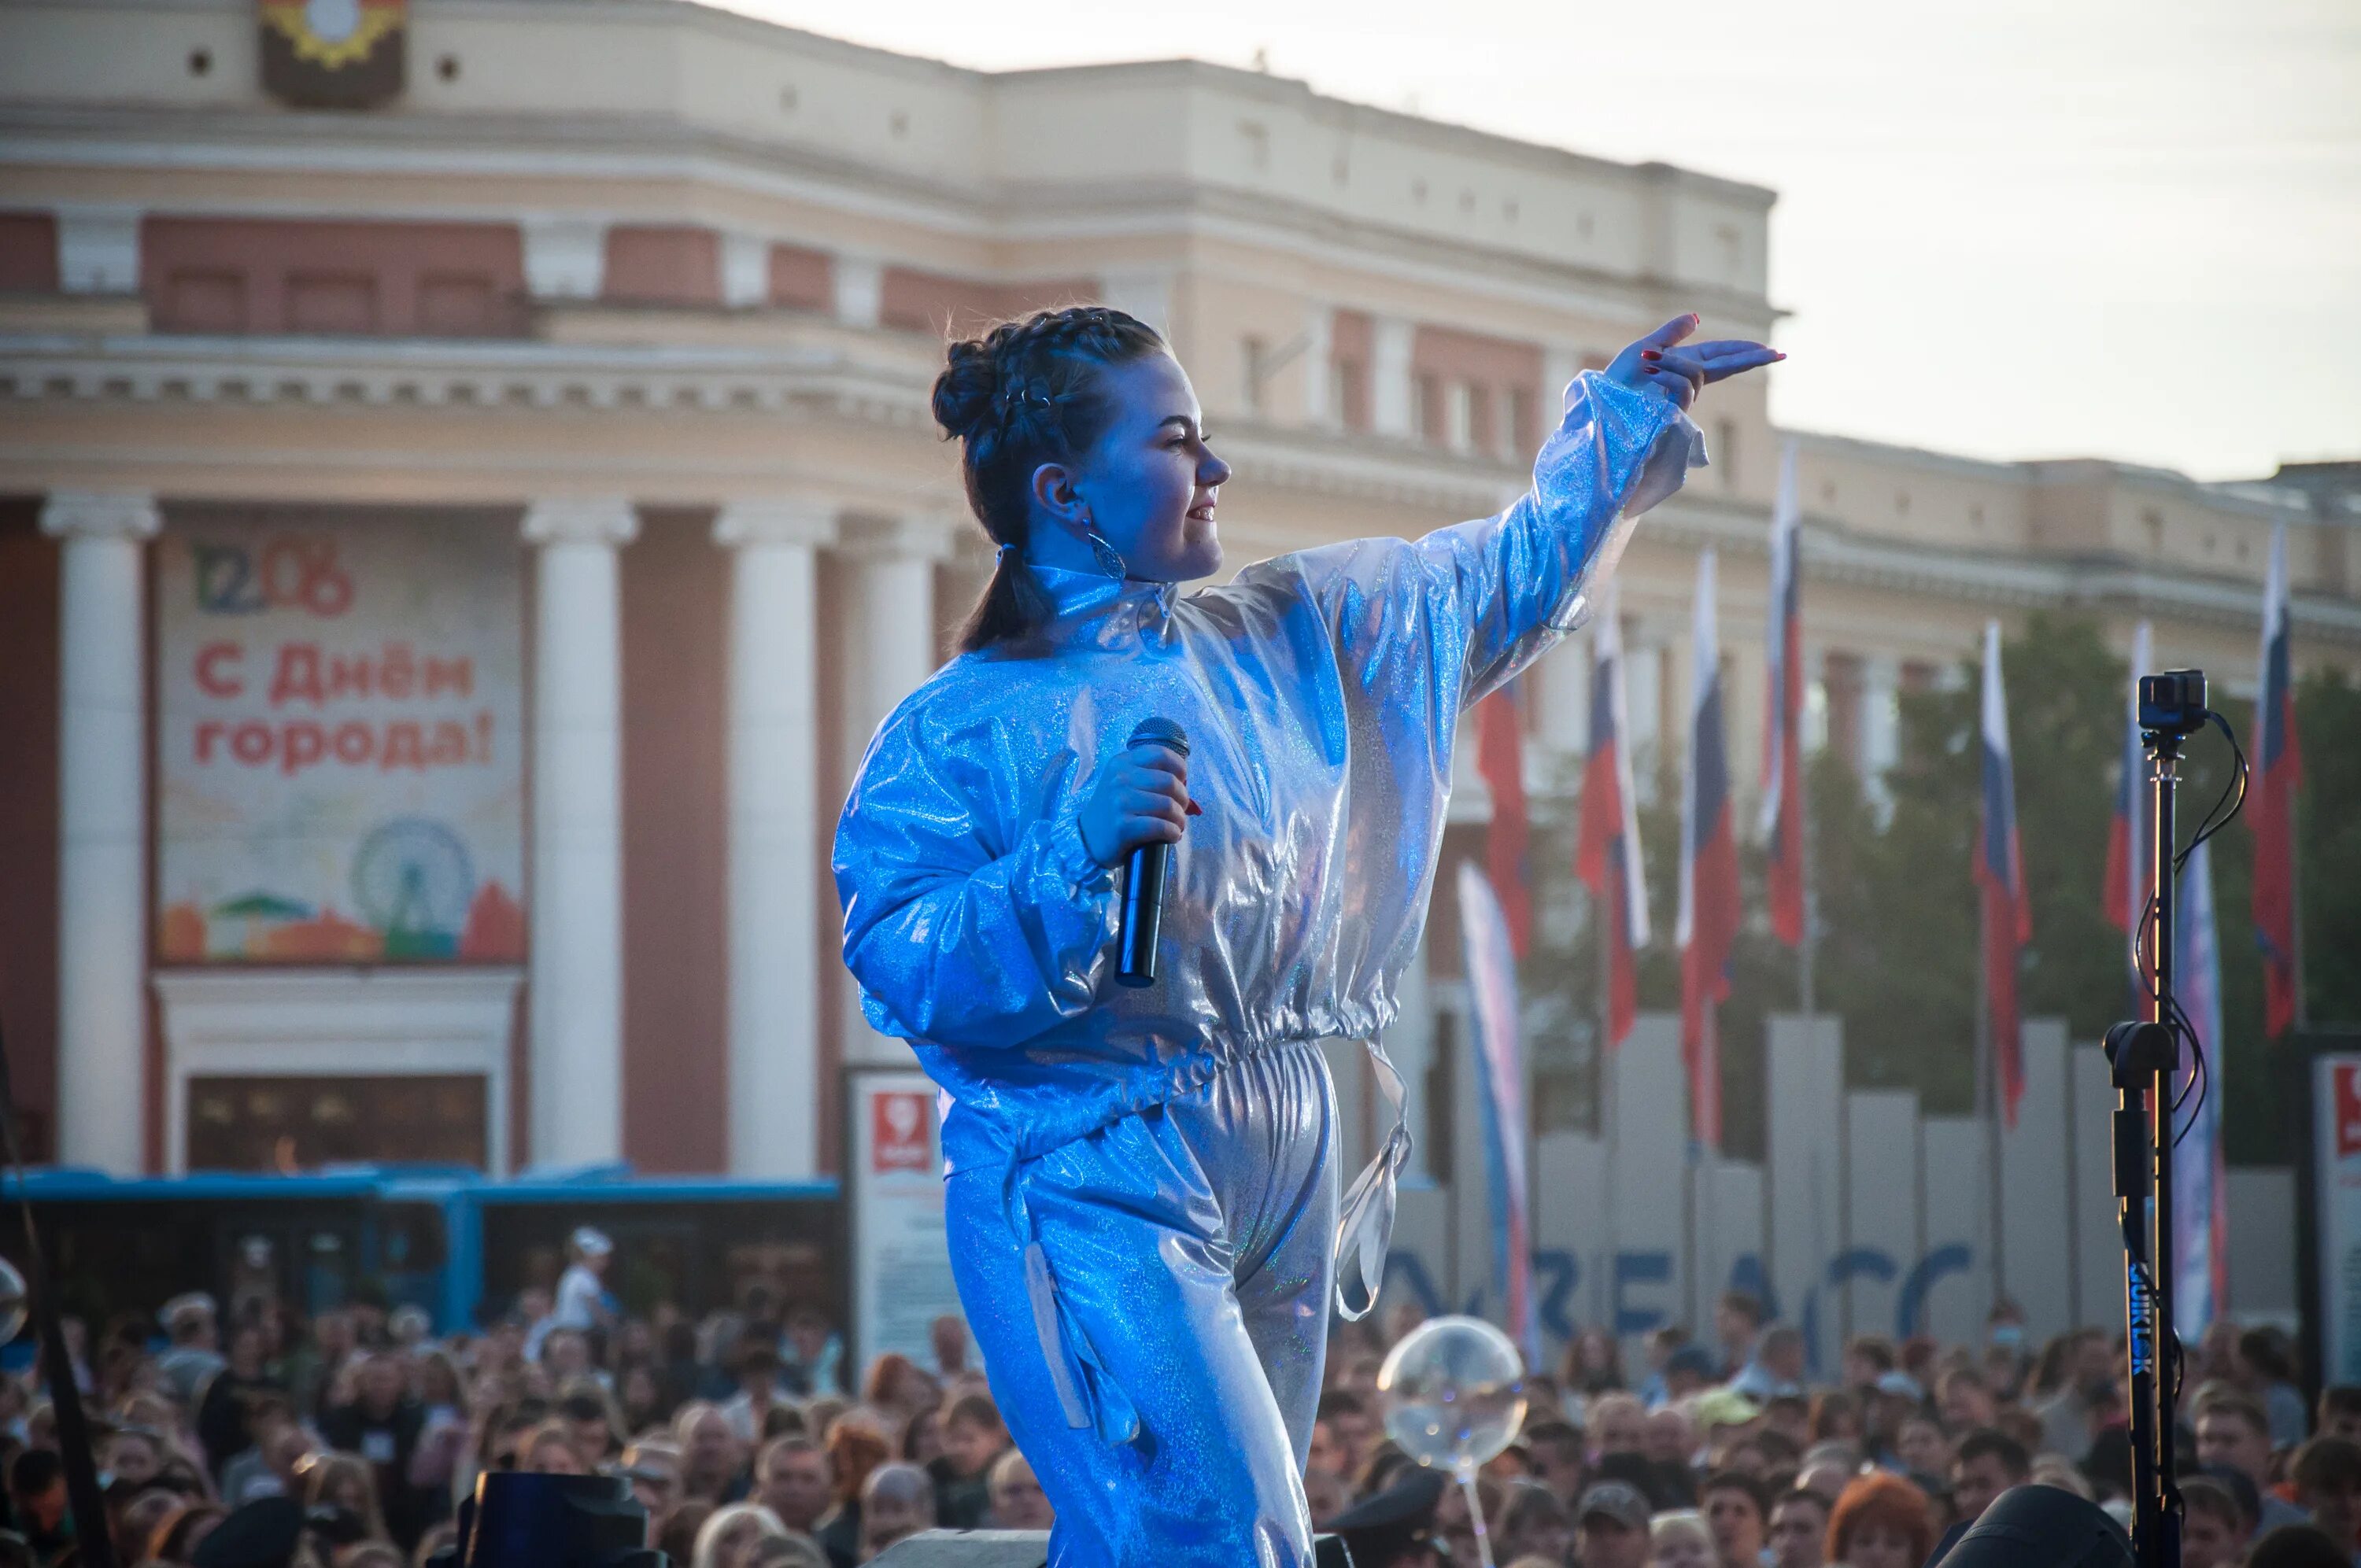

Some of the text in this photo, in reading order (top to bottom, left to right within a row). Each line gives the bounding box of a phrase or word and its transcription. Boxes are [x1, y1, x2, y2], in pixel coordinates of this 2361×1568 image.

[194, 641, 473, 707] С Днём
[195, 710, 493, 777] города!
